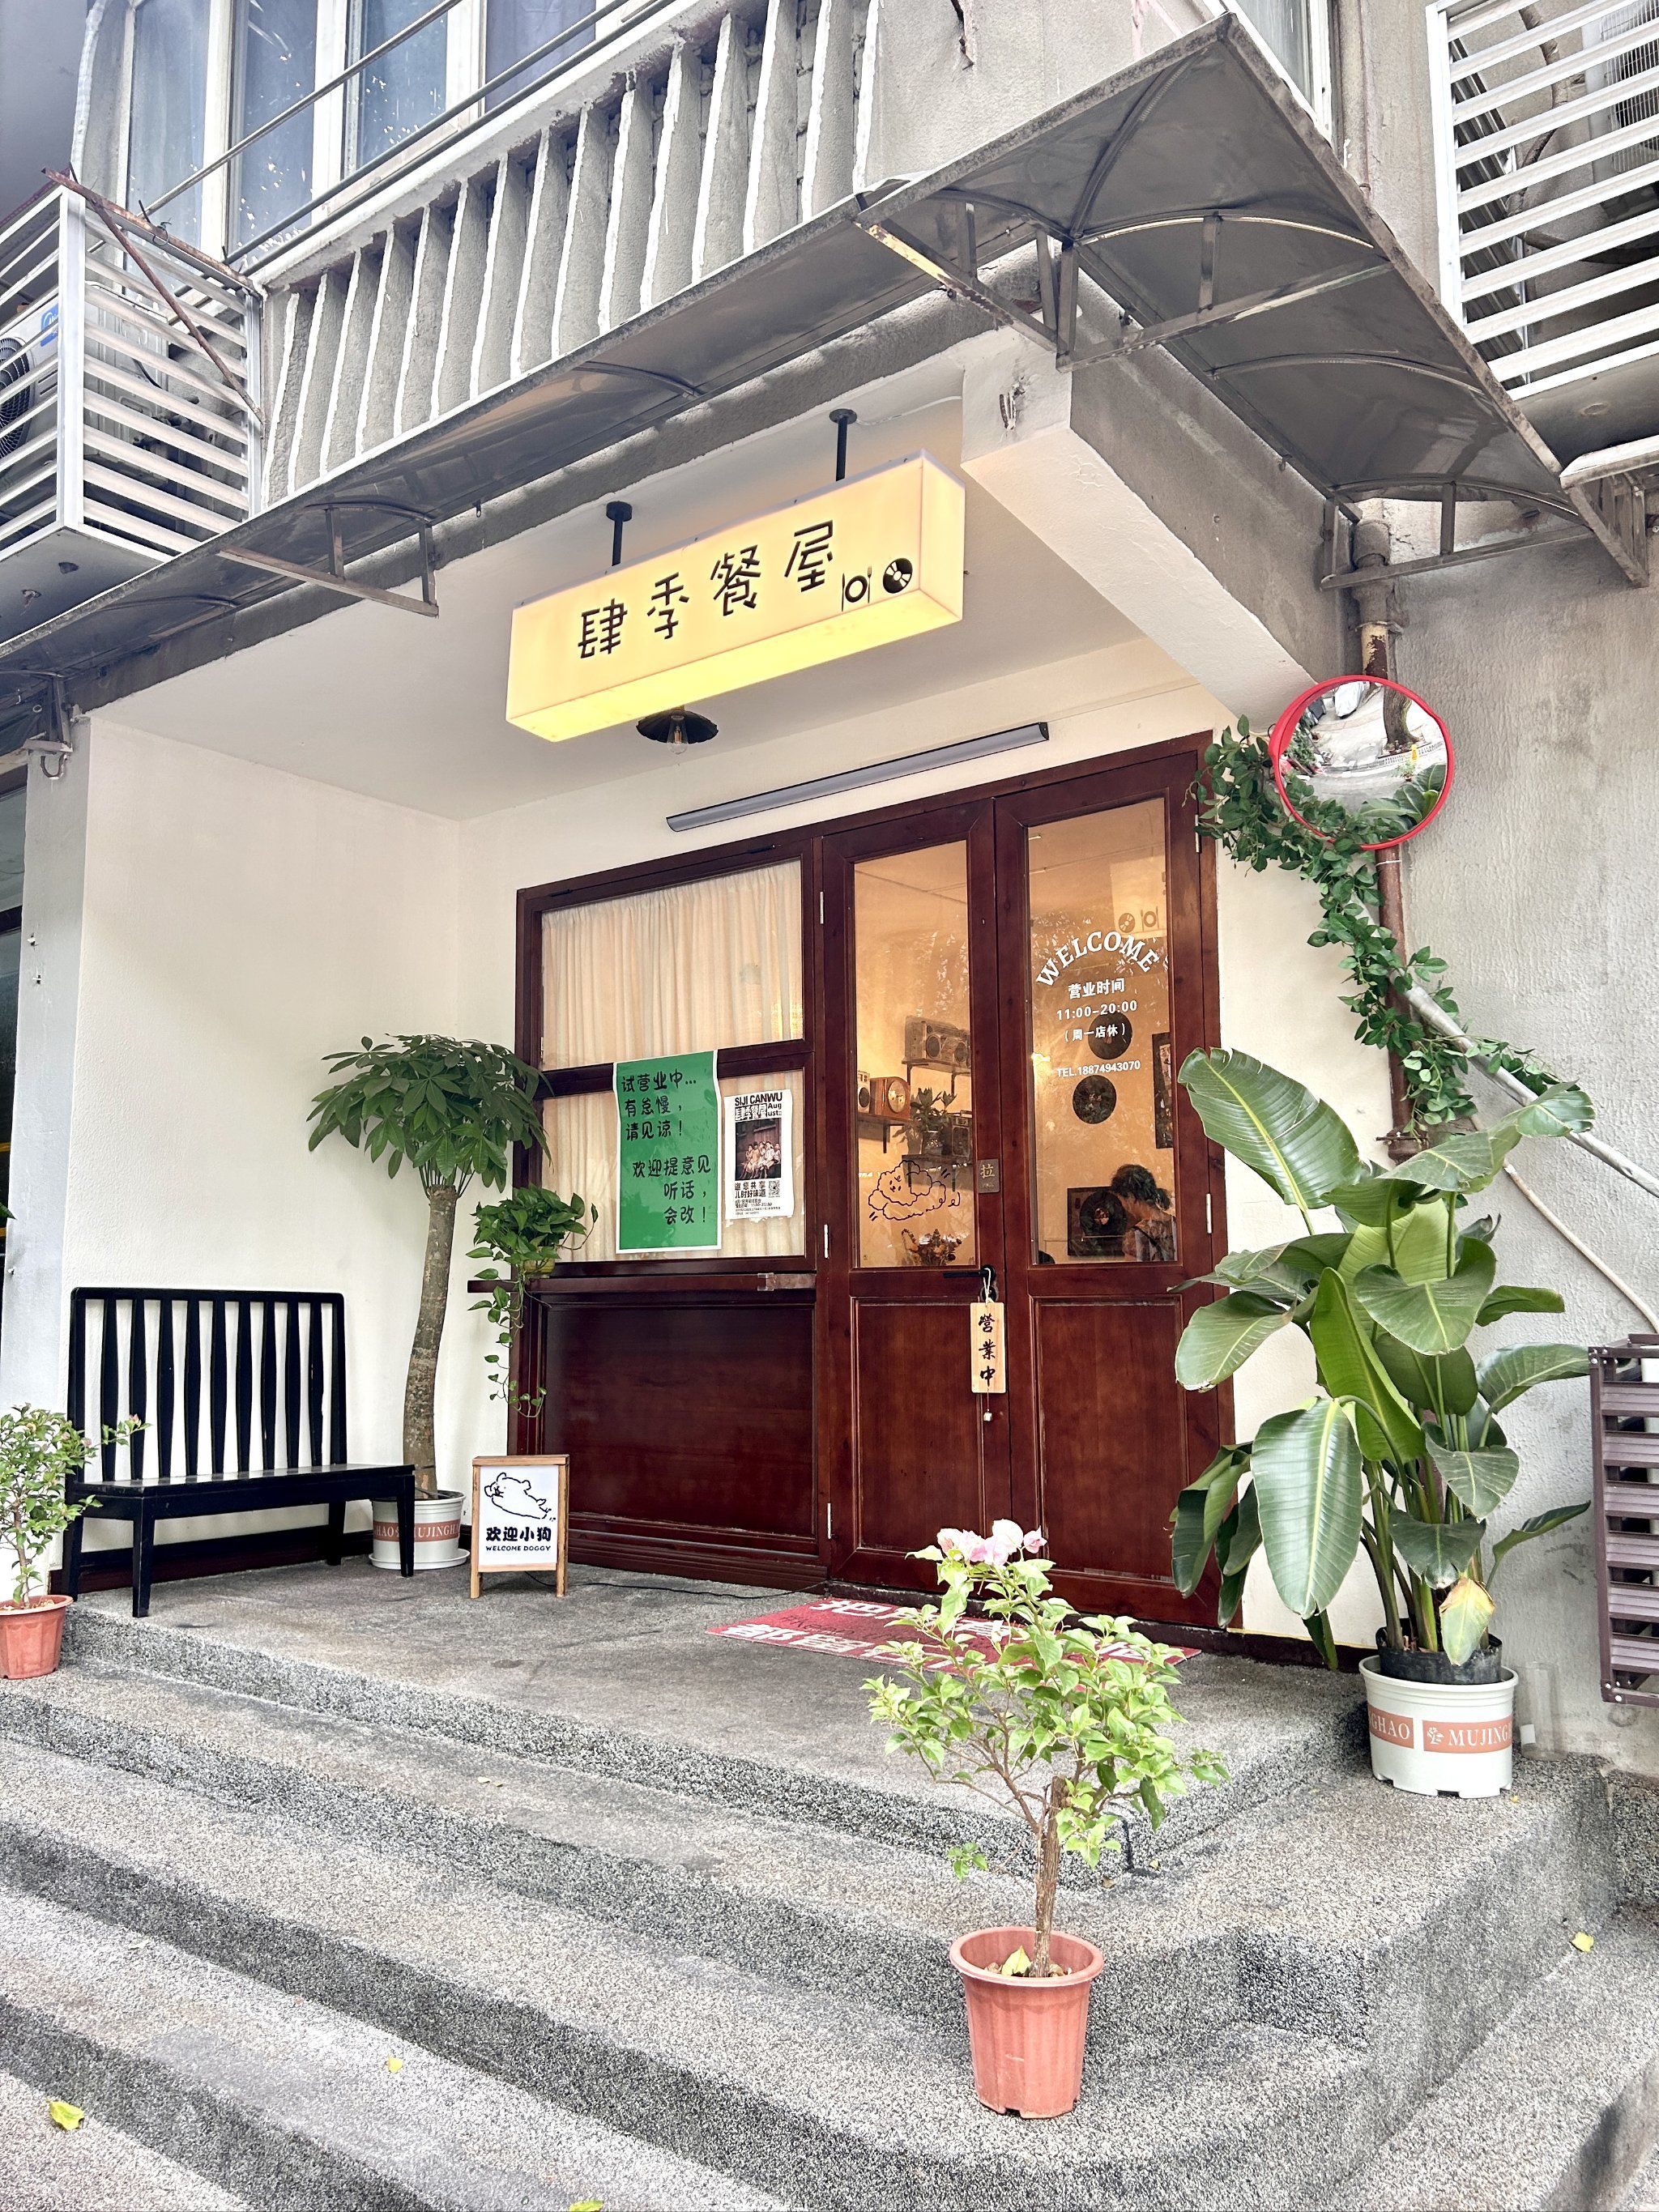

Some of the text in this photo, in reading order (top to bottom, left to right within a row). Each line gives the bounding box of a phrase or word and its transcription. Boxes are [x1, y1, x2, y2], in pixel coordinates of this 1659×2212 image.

[578, 519, 834, 659] 肆季餐屋
[1035, 931, 1160, 987] WELCOME
[1068, 978, 1125, 999] 营业时间
[734, 1092, 783, 1106] SIJI CANWU
[632, 1154, 711, 1178] 欢迎提意见
[979, 1163, 996, 1179] 拉
[978, 1313, 996, 1387] 營業中
[486, 1526, 552, 1542] 欢迎小狗
